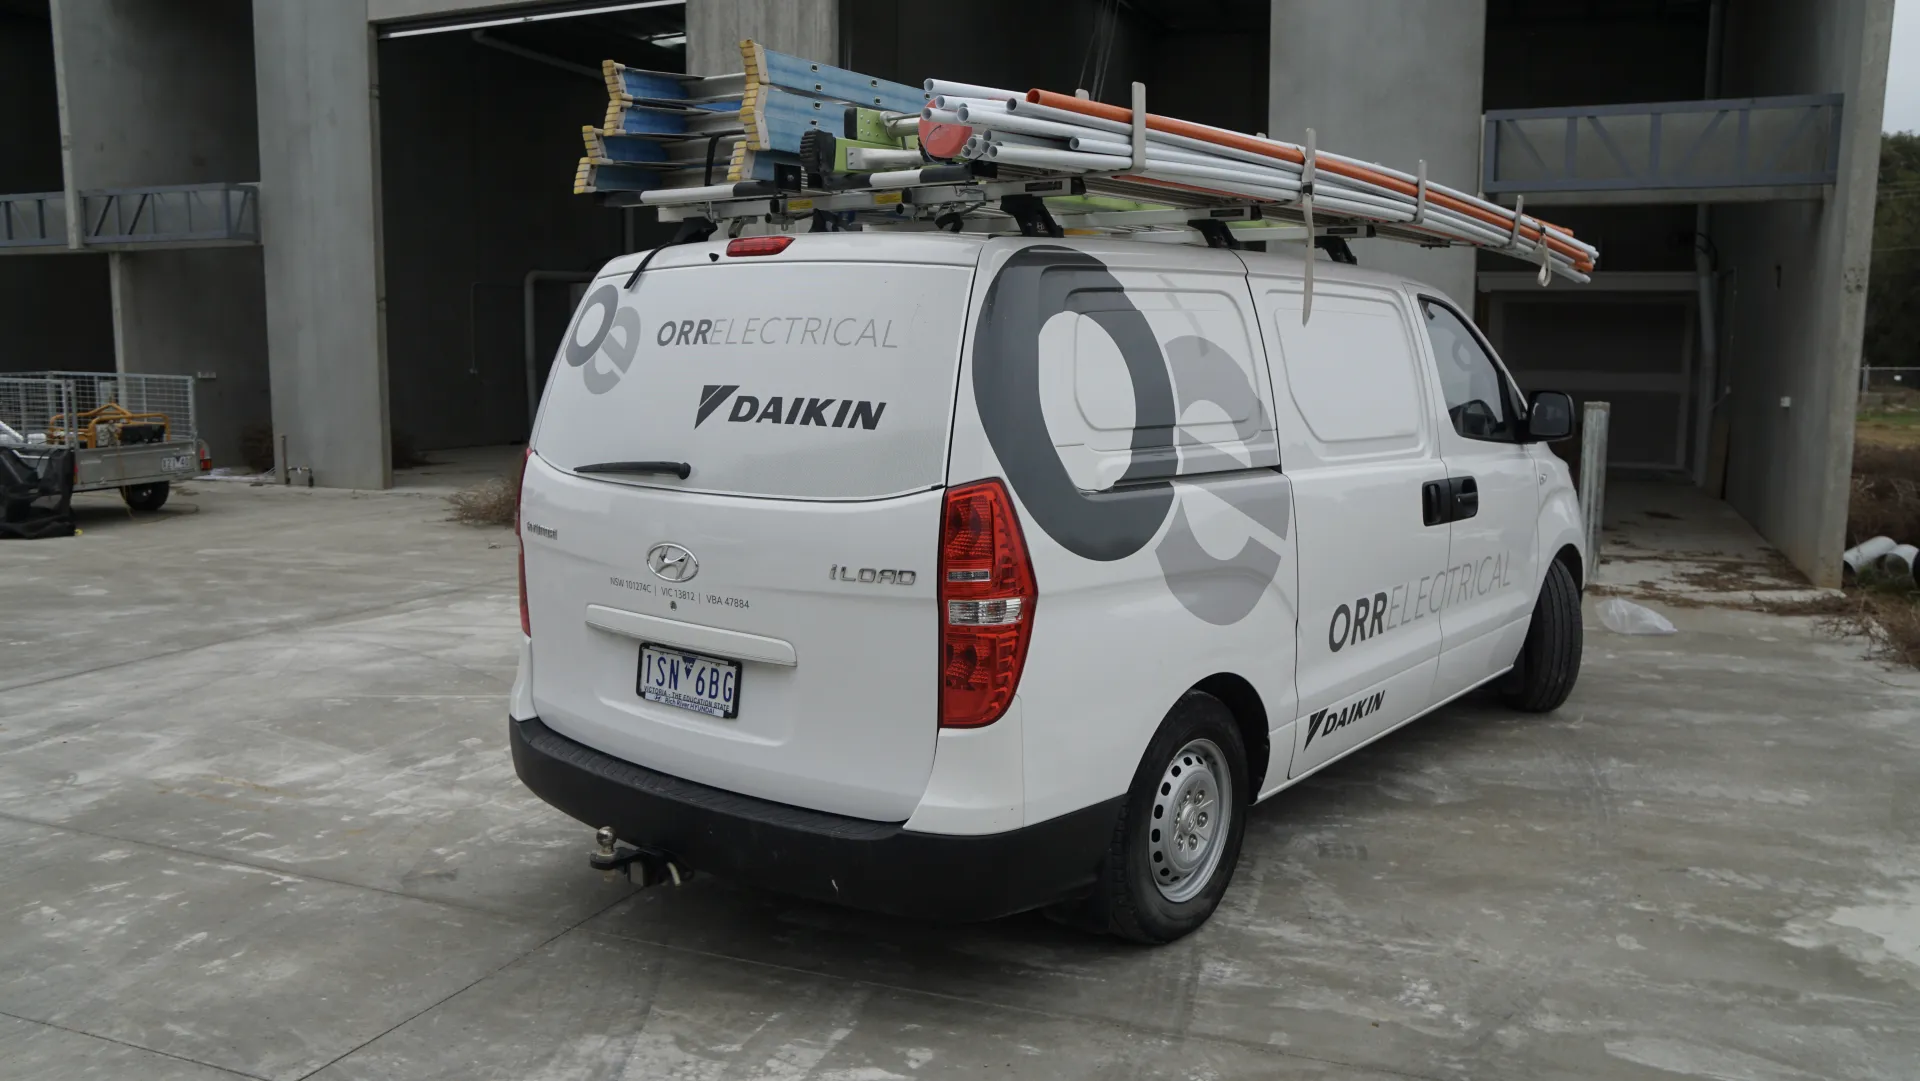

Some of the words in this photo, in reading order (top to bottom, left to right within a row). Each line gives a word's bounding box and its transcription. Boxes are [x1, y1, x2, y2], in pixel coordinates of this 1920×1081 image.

[728, 396, 886, 431] DAIKIN
[829, 564, 917, 585] iLOAD
[610, 577, 624, 587] NSW
[626, 580, 651, 593] 101274C
[661, 587, 673, 597] VIC
[674, 589, 695, 601] 13812
[706, 594, 722, 606] VBA
[724, 597, 749, 609] 47884
[646, 654, 680, 691] 1SN
[695, 666, 734, 703] 6BG
[643, 685, 667, 697] VICTORIA
[672, 692, 682, 700] THE
[682, 694, 714, 708] EDUCATION
[713, 702, 730, 712] STATE
[664, 697, 676, 705] Rich
[676, 699, 690, 709] River
[690, 702, 715, 715] HYUNDAI
[1322, 690, 1386, 738] DAIKIN
